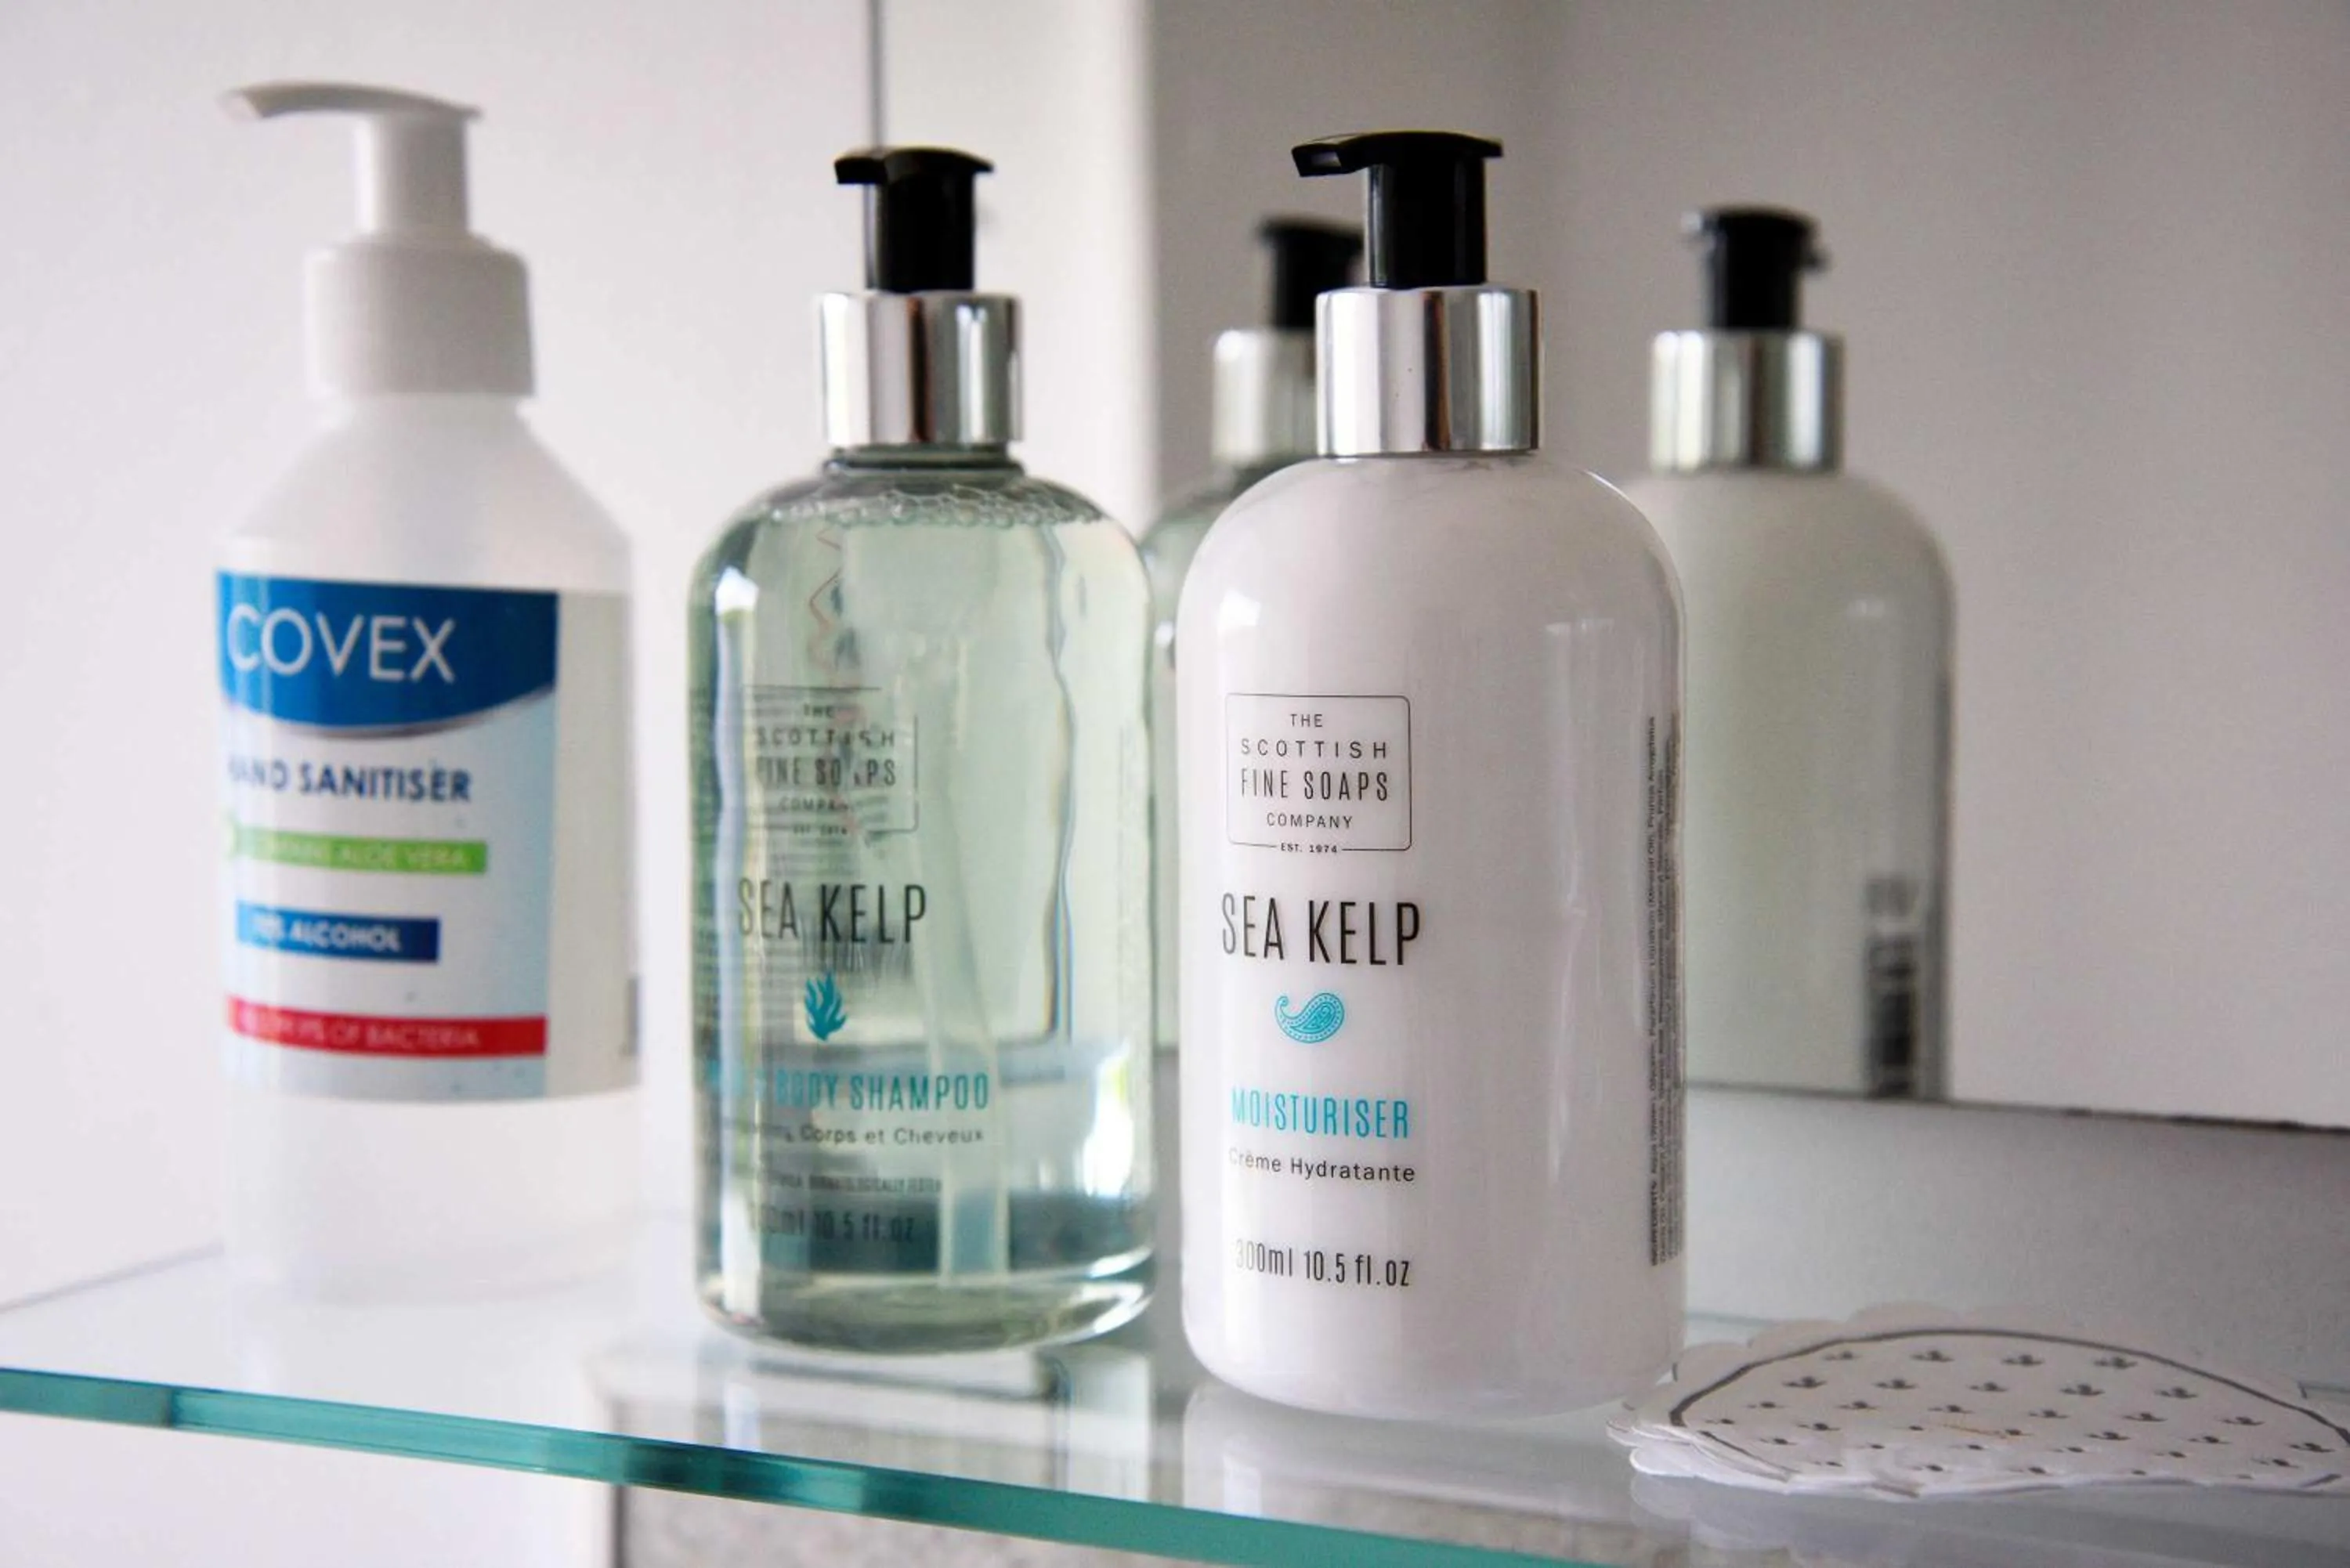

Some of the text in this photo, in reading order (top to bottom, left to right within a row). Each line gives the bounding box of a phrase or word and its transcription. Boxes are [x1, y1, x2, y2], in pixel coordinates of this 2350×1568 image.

[226, 602, 457, 683] COVEX
[1290, 713, 1324, 728] THE
[1241, 738, 1387, 759] SCOTTISH
[299, 761, 472, 802] SANITISER
[1241, 768, 1388, 801] FINE SOAPS
[1266, 812, 1353, 829] COMPANY
[1280, 843, 1338, 854] EST. 1974
[738, 877, 927, 945] SEA KELP
[1222, 892, 1421, 966] SEA KELP
[289, 918, 402, 953] ALCOHOL
[774, 1069, 840, 1108] BODY
[849, 1071, 990, 1111] SHAMPOO
[1231, 1087, 1410, 1140] MOISTURISER
[800, 1125, 857, 1146] Corps
[865, 1128, 885, 1144] et
[893, 1126, 985, 1144] Cheveux
[1228, 1147, 1416, 1183] Crème Hydratante
[1235, 1237, 1411, 1288] 300ml 10.5 fl.oz
